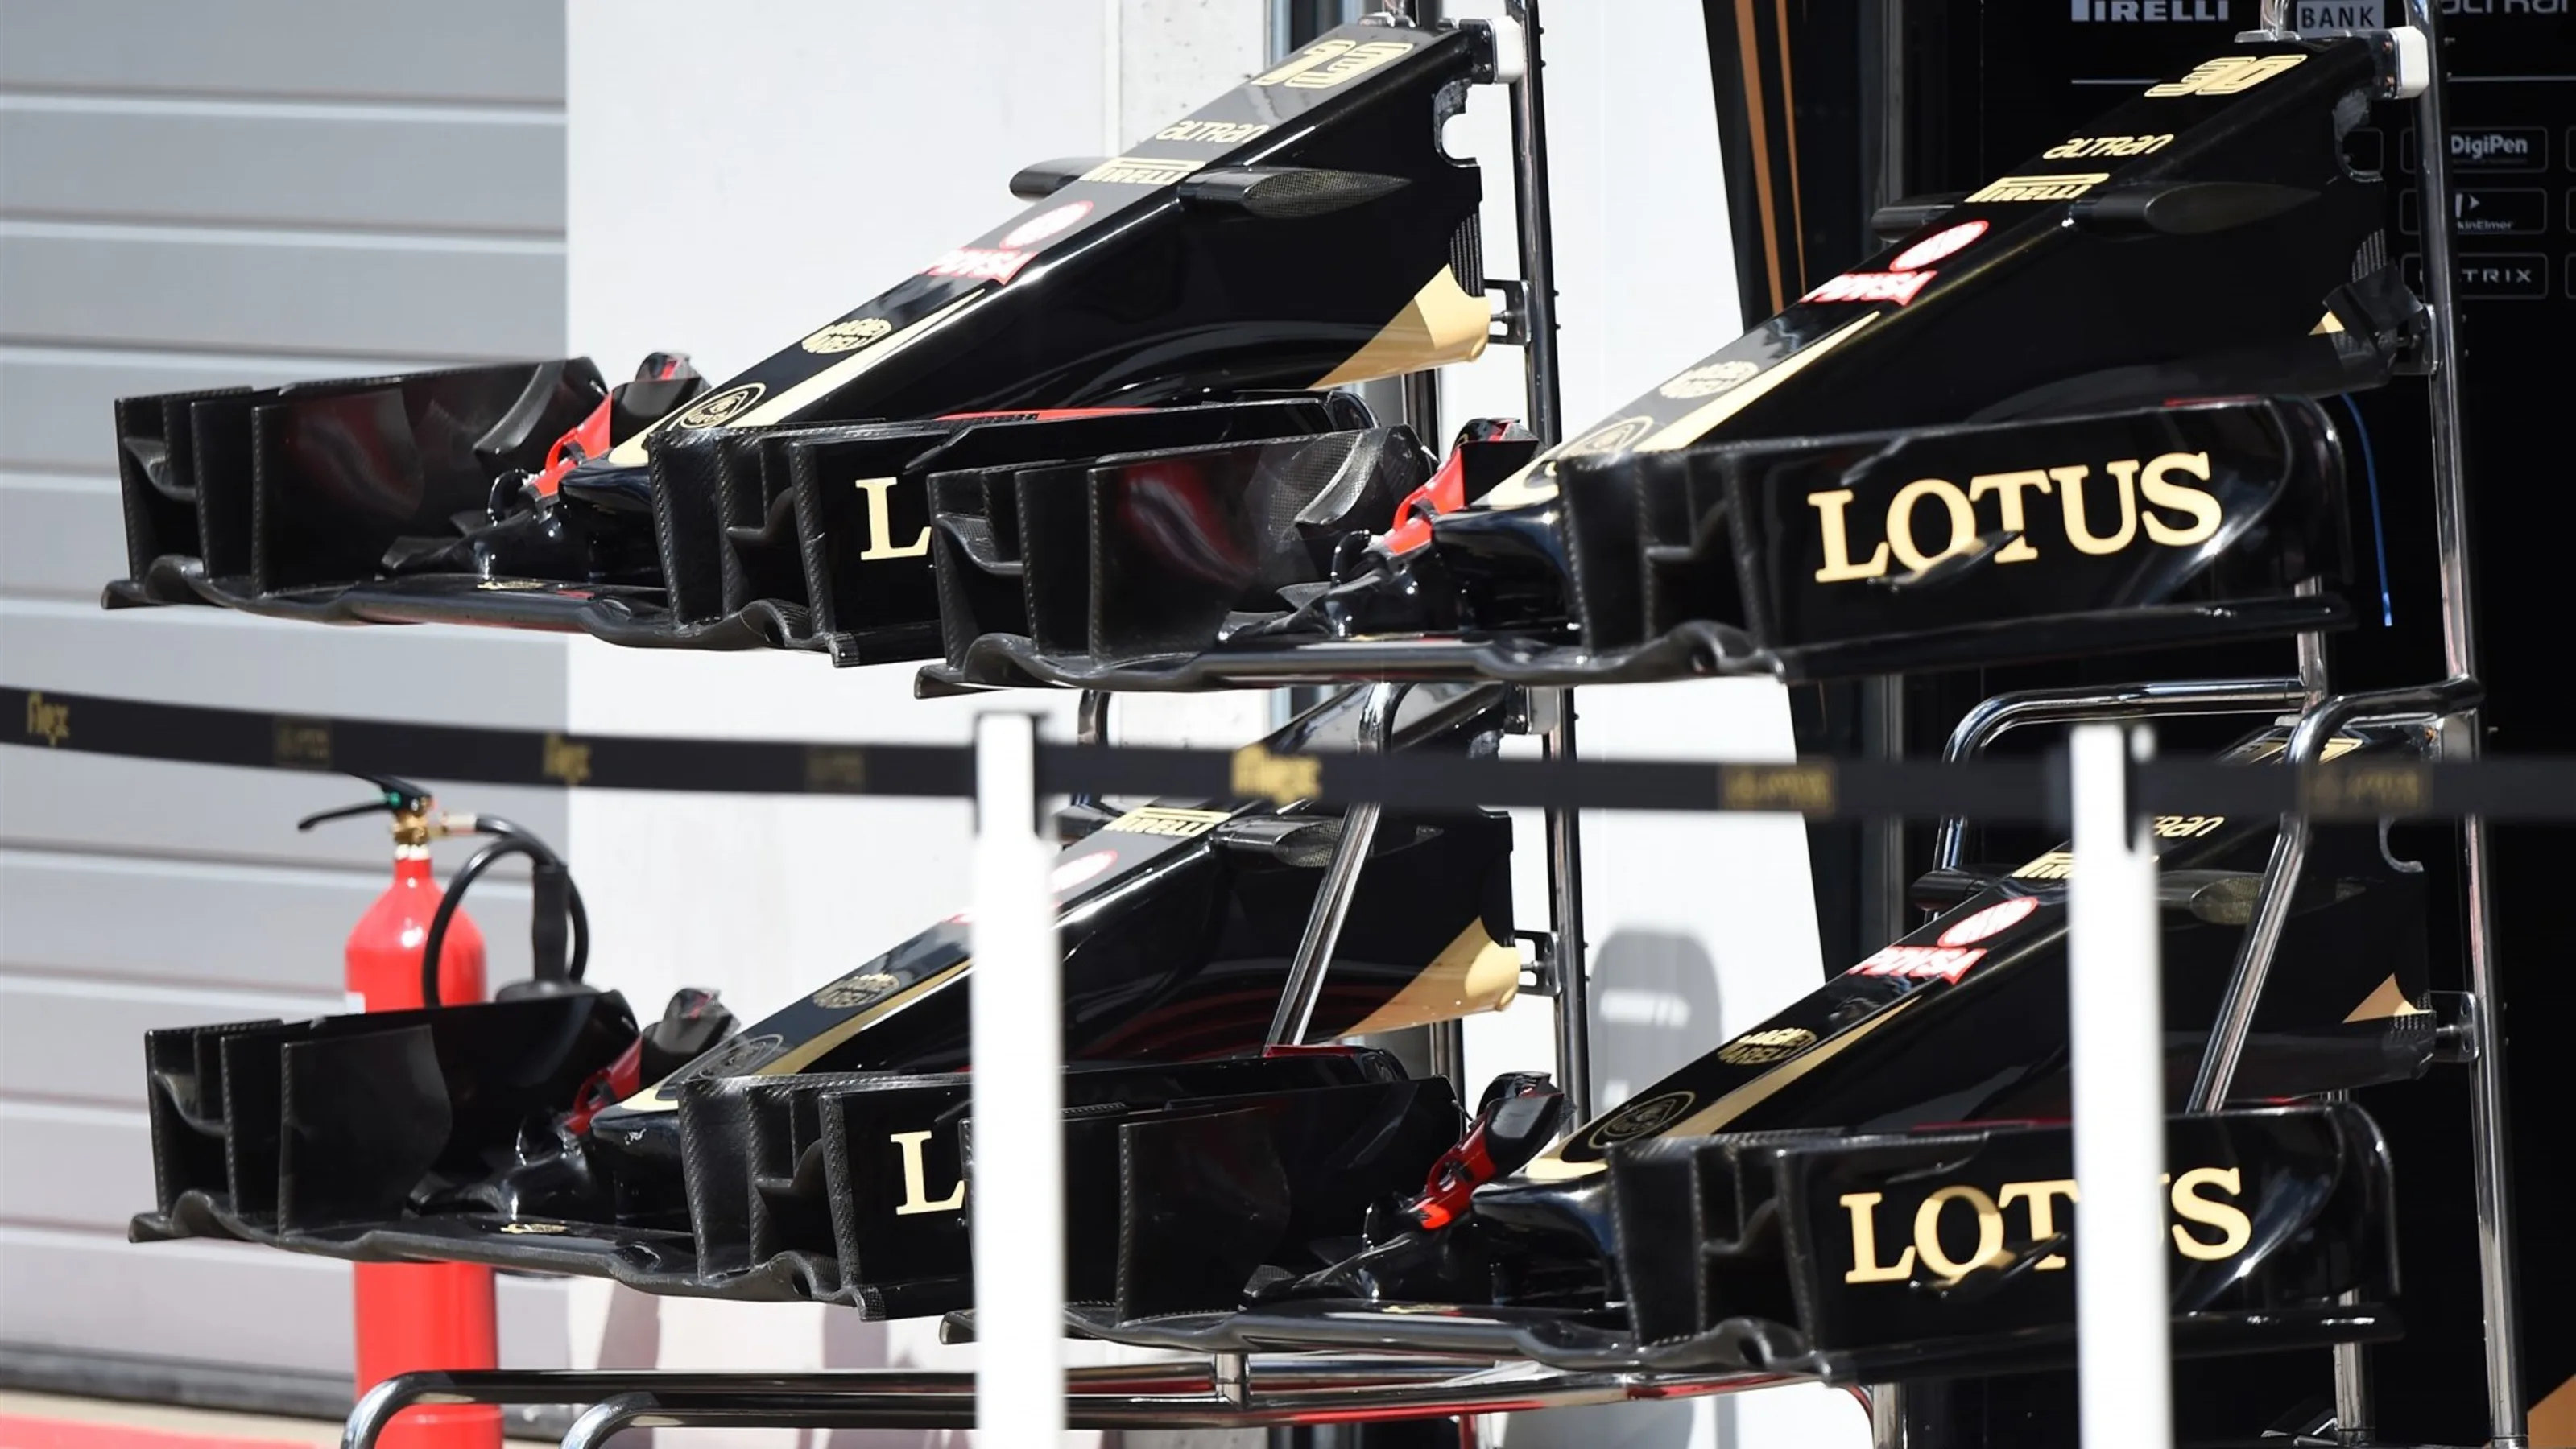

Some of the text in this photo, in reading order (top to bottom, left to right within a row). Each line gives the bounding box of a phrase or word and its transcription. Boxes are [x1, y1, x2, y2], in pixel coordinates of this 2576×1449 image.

[2301, 6, 2375, 28] BANK
[1251, 39, 1414, 89] 13
[2450, 134, 2528, 159] DigiPen
[1963, 173, 2110, 202] PIRELLI
[2420, 268, 2532, 283] TRIX
[1807, 451, 2222, 584] LOTUS
[1840, 1167, 2252, 1286] LOTS
